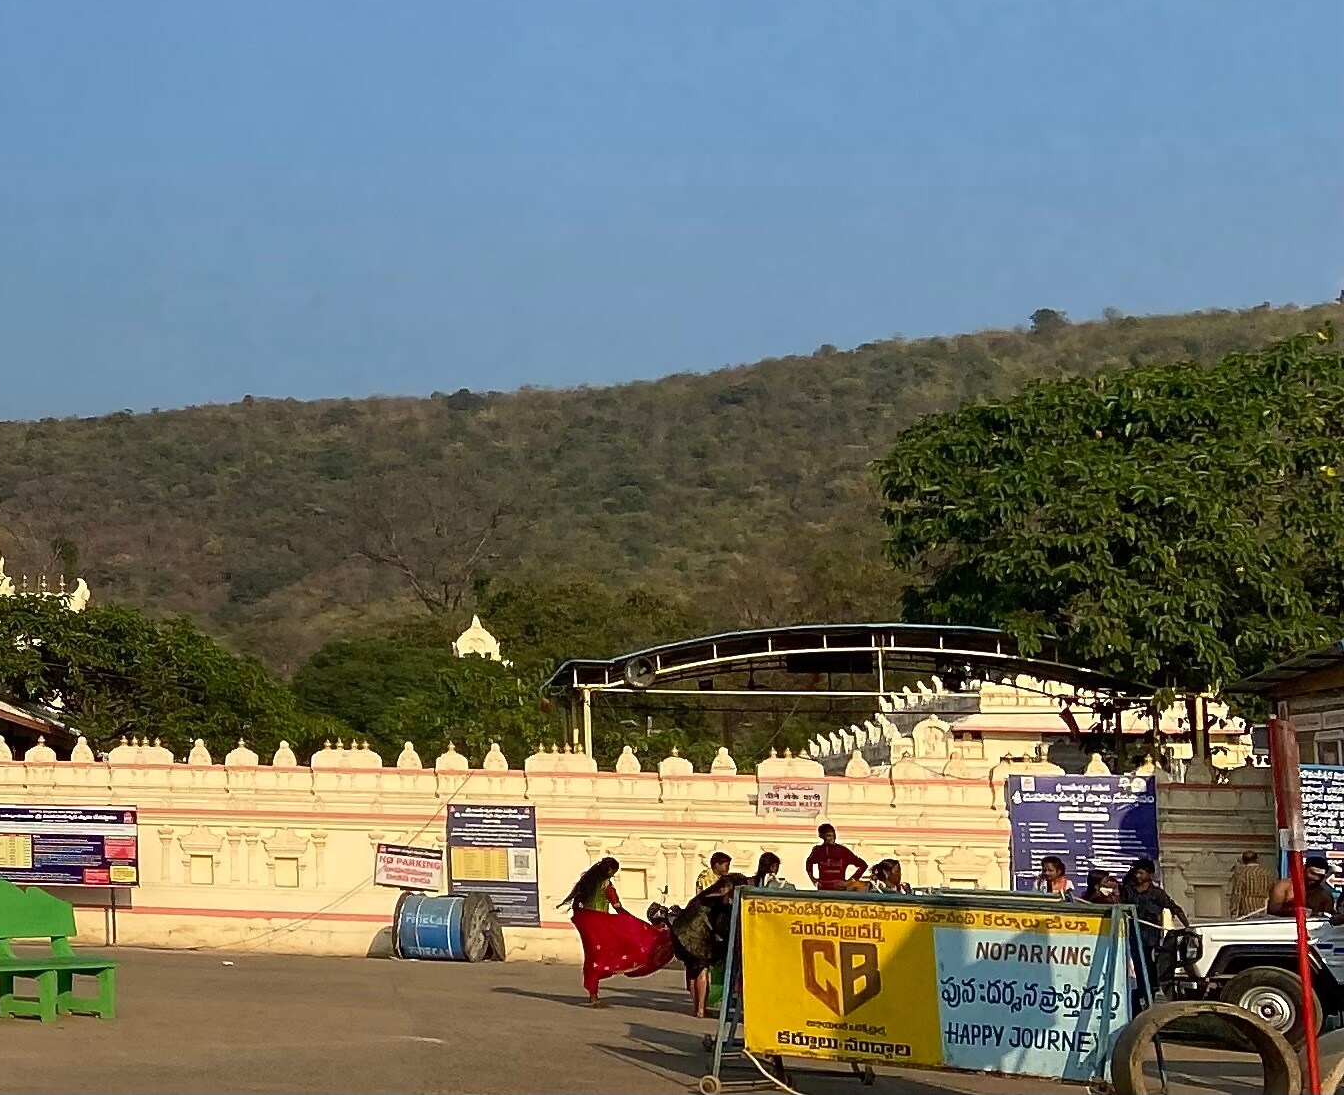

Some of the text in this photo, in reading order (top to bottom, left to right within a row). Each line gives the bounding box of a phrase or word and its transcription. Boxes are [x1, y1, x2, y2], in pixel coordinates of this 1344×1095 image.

[379, 855, 441, 870] NO PARKING
[944, 1021, 1005, 1048] HAPPY
